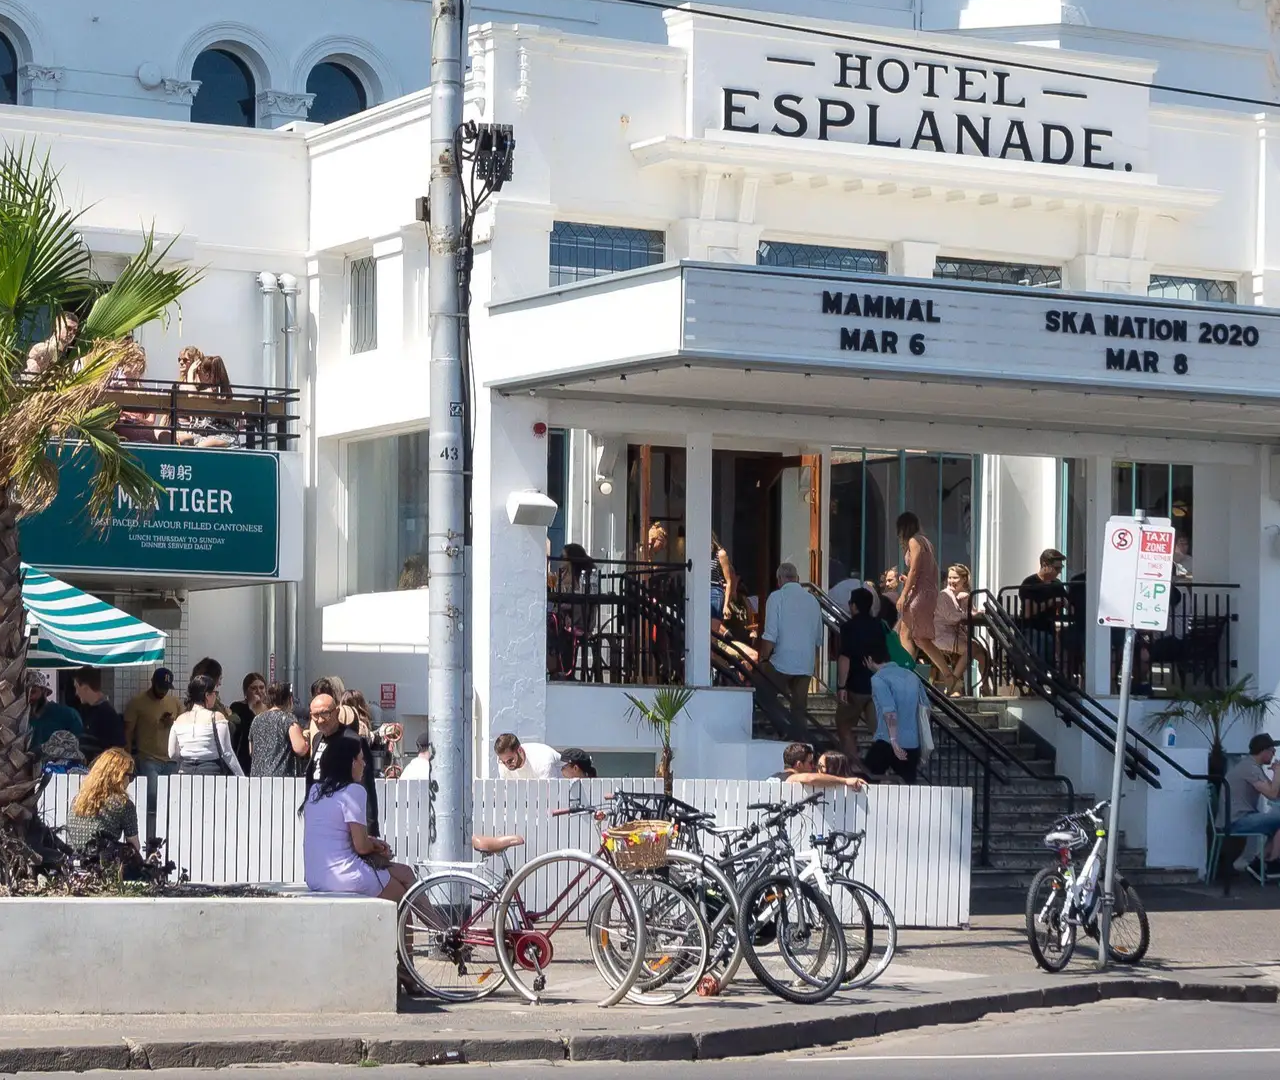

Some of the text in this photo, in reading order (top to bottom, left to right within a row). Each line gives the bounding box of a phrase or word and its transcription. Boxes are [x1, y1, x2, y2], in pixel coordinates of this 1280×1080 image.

[834, 52, 1026, 108] HOTEL
[821, 290, 941, 323] MAMMAL
[1045, 311, 1259, 347] SKA NATION 2020
[839, 327, 926, 356] MAR 6
[1106, 347, 1188, 375] MAR 8
[440, 447, 459, 461] 43
[166, 487, 233, 514] TIGER
[143, 520, 181, 529] FLAVOUR
[183, 522, 212, 531] FILLED
[213, 523, 263, 533] CANTONESE
[1145, 531, 1170, 542] TAXI
[141, 541, 213, 551] DINNER SERVED DAILY
[153, 535, 187, 543] THURSDAY
[199, 537, 226, 545] SUNDAY
[1145, 542, 1167, 552] ZONE
